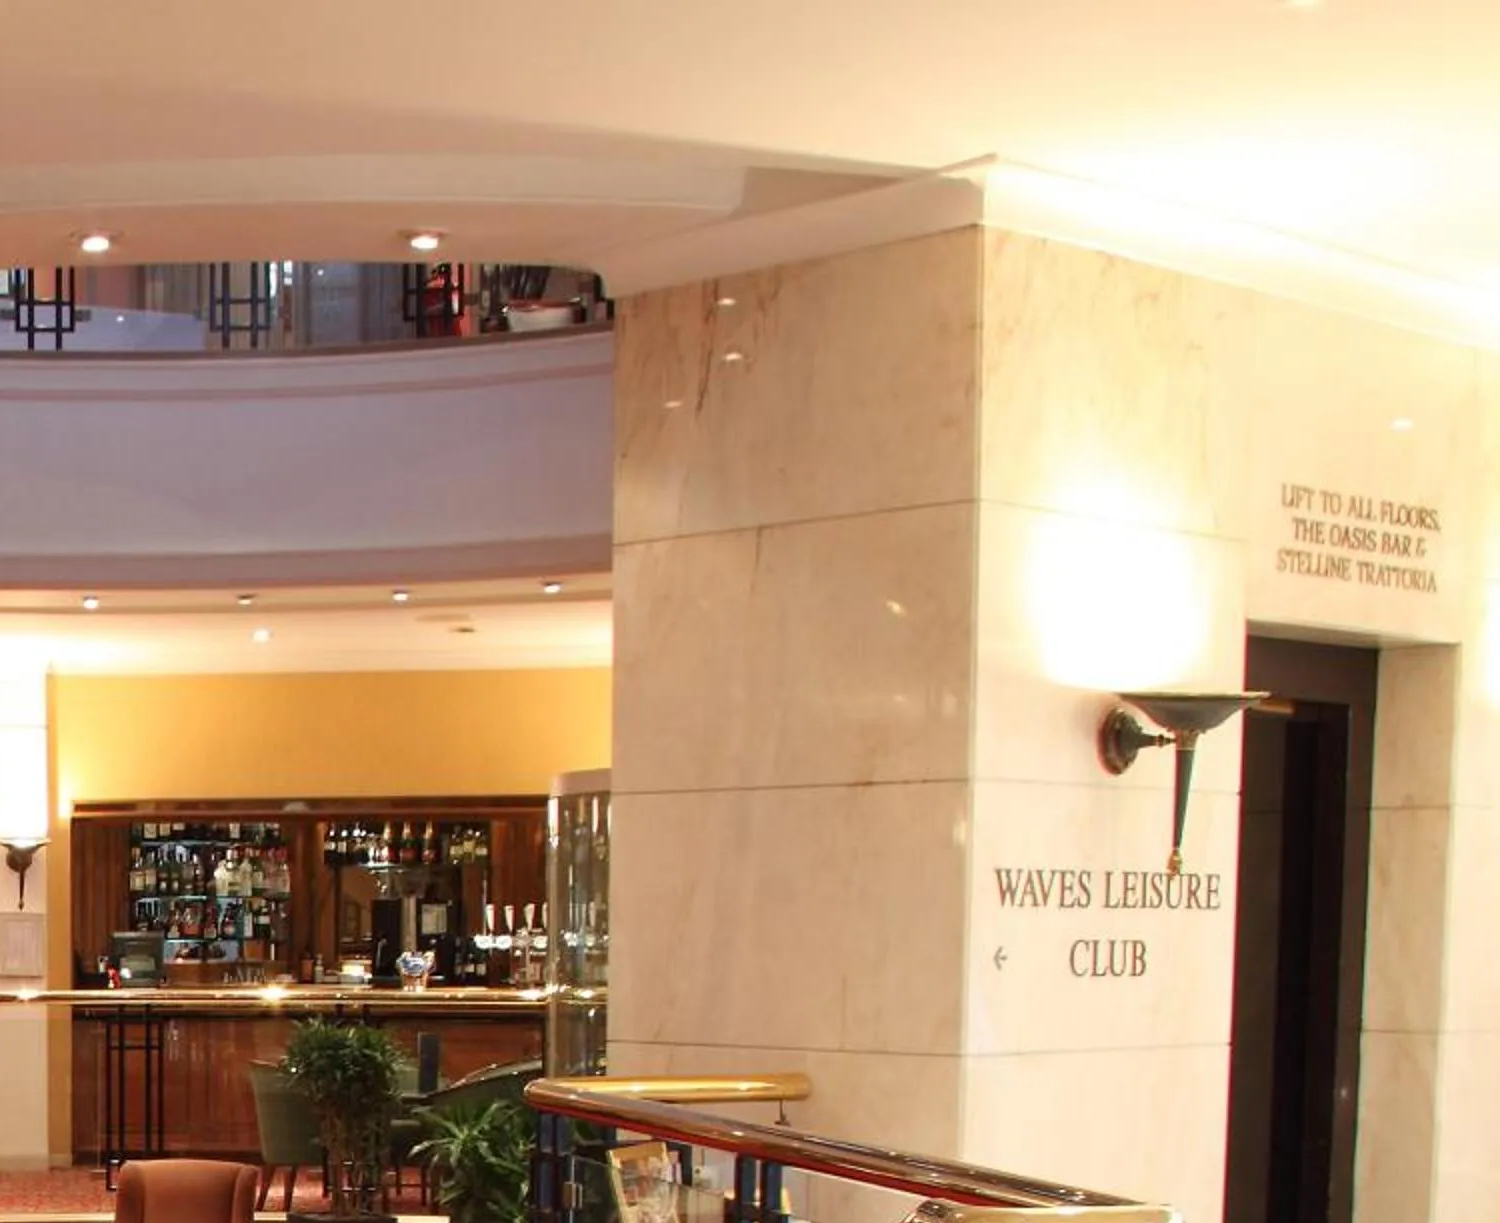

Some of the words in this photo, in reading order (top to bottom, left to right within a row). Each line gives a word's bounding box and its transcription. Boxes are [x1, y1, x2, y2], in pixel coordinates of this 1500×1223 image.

[1281, 482, 1315, 512] LIFT
[1320, 489, 1342, 516] TO
[1347, 496, 1376, 521] ALL
[1292, 517, 1325, 545] THE
[1329, 523, 1377, 552] OASIS
[1380, 531, 1411, 558] BAR
[1276, 547, 1352, 582] STELLINE
[1356, 560, 1438, 594] TRATTORIA
[995, 867, 1092, 908] WAVES
[1103, 870, 1221, 911] LEISURE
[1069, 938, 1148, 978] CLUB
